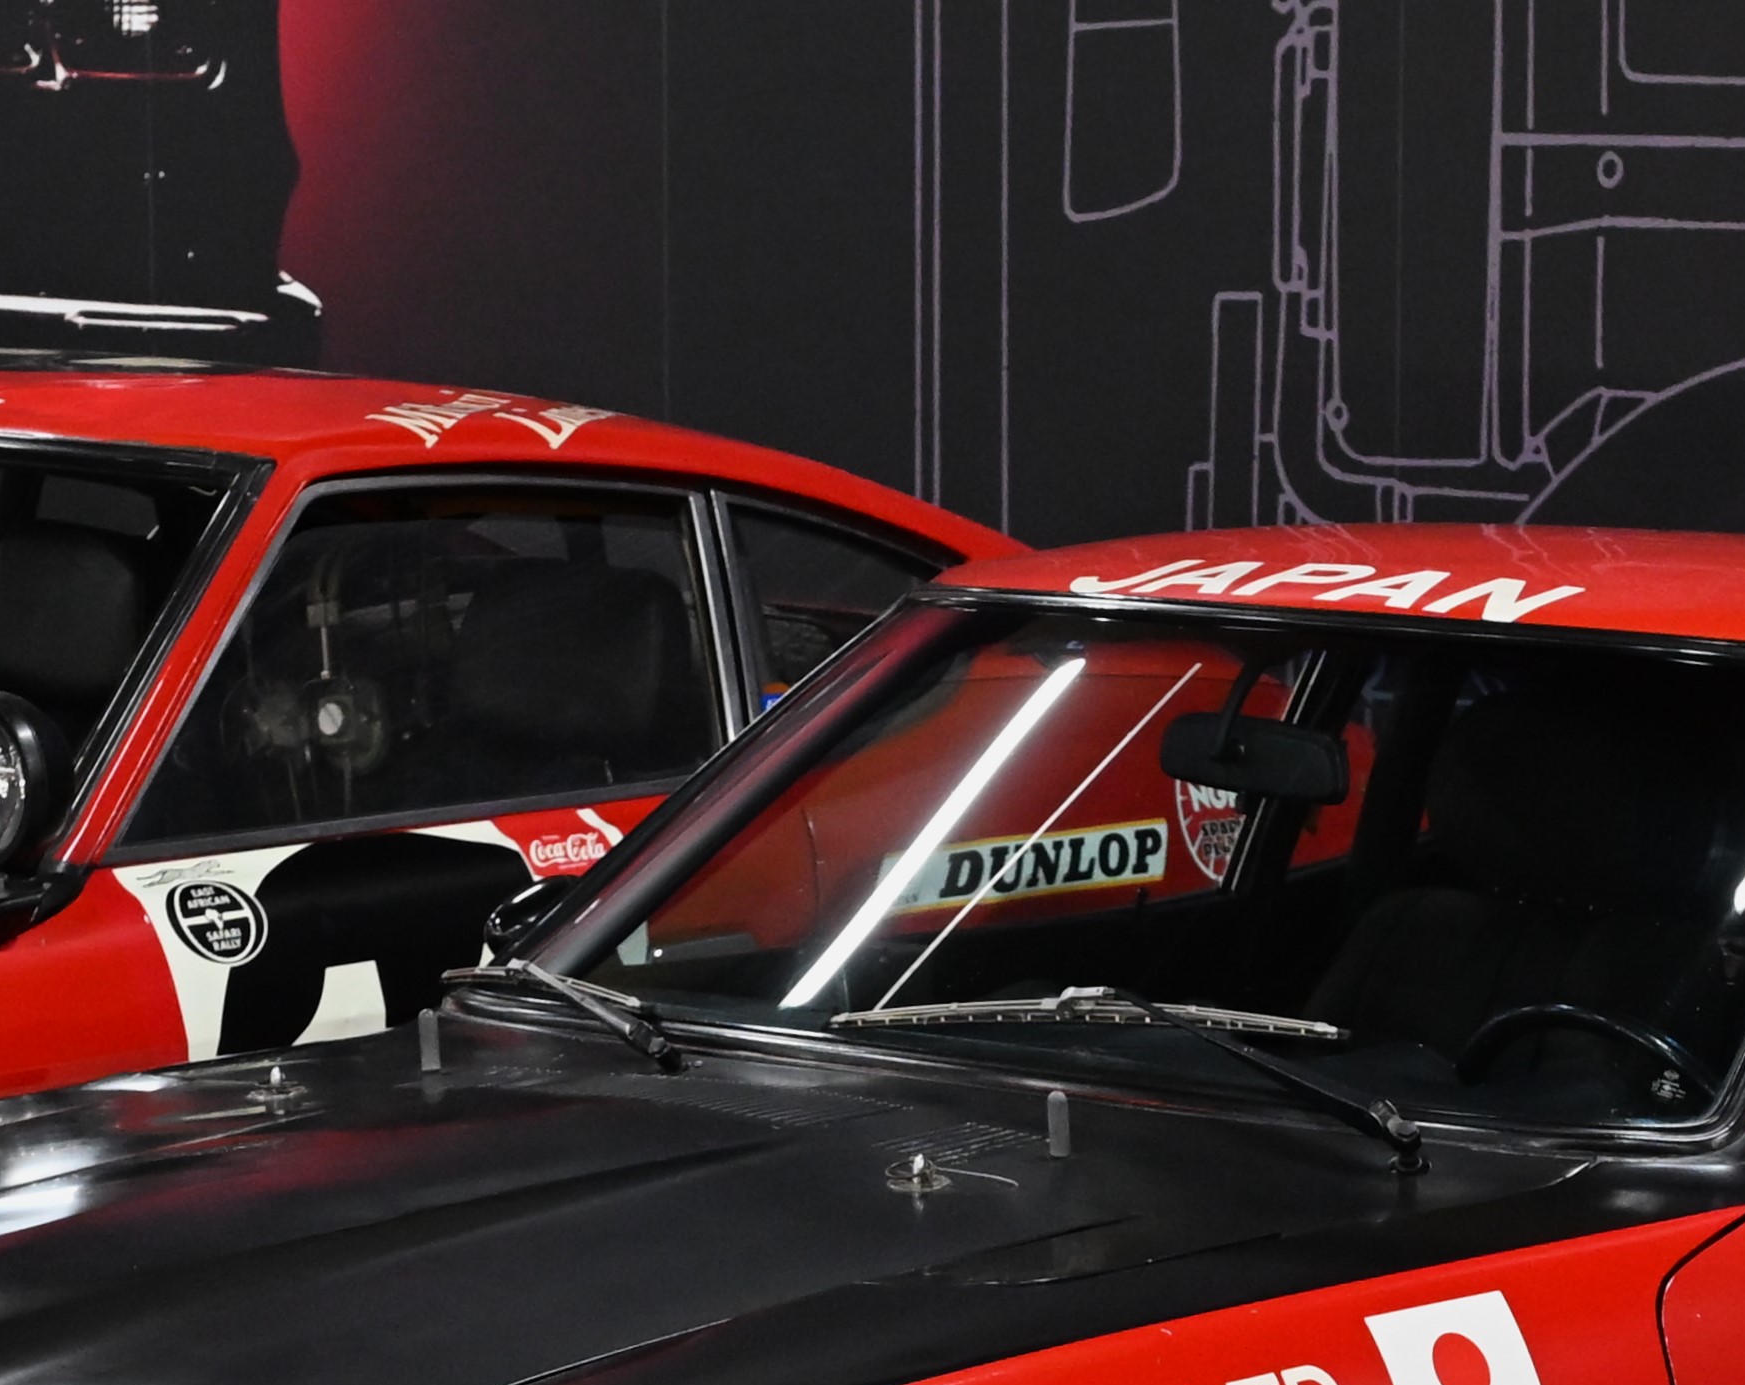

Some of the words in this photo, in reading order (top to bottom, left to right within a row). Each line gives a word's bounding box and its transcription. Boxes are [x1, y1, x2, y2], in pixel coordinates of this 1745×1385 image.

[1067, 558, 1585, 623] JAPAN
[939, 826, 1163, 899] DUNLOP
[186, 894, 232, 910] AFRICAN
